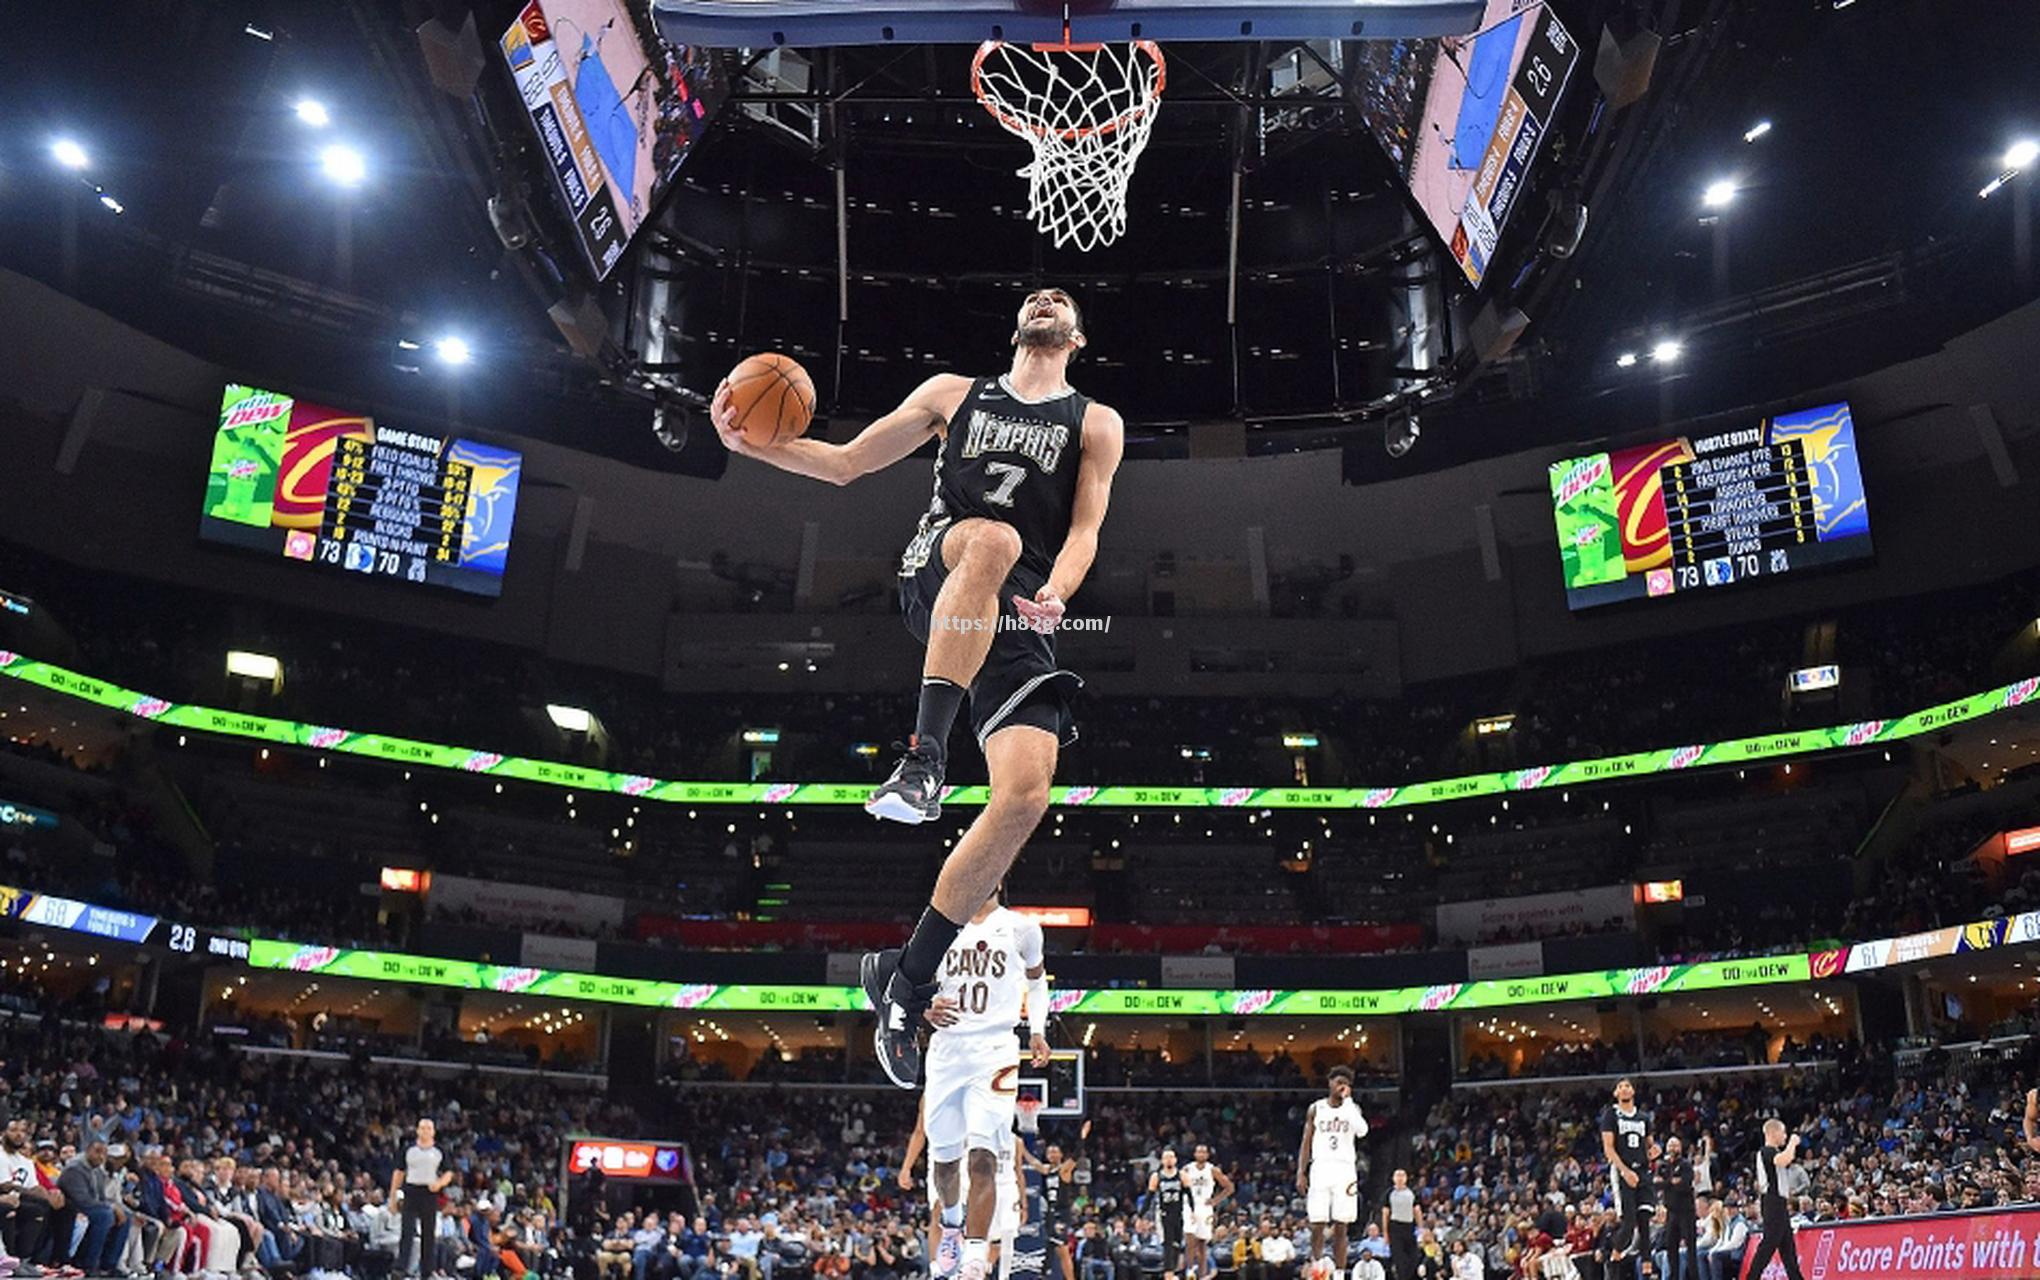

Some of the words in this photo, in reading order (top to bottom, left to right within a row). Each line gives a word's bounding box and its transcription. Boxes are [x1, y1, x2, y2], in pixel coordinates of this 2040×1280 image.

[962, 409, 1069, 475] MEMPHIS
[982, 461, 1028, 508] 7
[319, 540, 341, 563] 73
[378, 551, 401, 575] 70
[1737, 554, 1760, 577] 70
[1677, 566, 1700, 588] 73
[1947, 703, 1970, 719] DEW
[168, 924, 196, 952] 2.6
[383, 961, 400, 974] DO
[418, 965, 447, 978] DEW
[946, 949, 1007, 979] CAVS
[1759, 963, 1790, 977] DEW
[791, 992, 819, 1005] DEW
[958, 981, 989, 1014] 10
[1508, 984, 1525, 998] DO
[1541, 981, 1569, 995] DEW
[1157, 995, 1183, 1008] DEW
[1352, 996, 1379, 1008] DEW
[1329, 1135, 1339, 1150] 3
[1837, 1240, 1893, 1273] Score
[1896, 1234, 1965, 1272] Points
[1972, 1229, 2027, 1268] with
